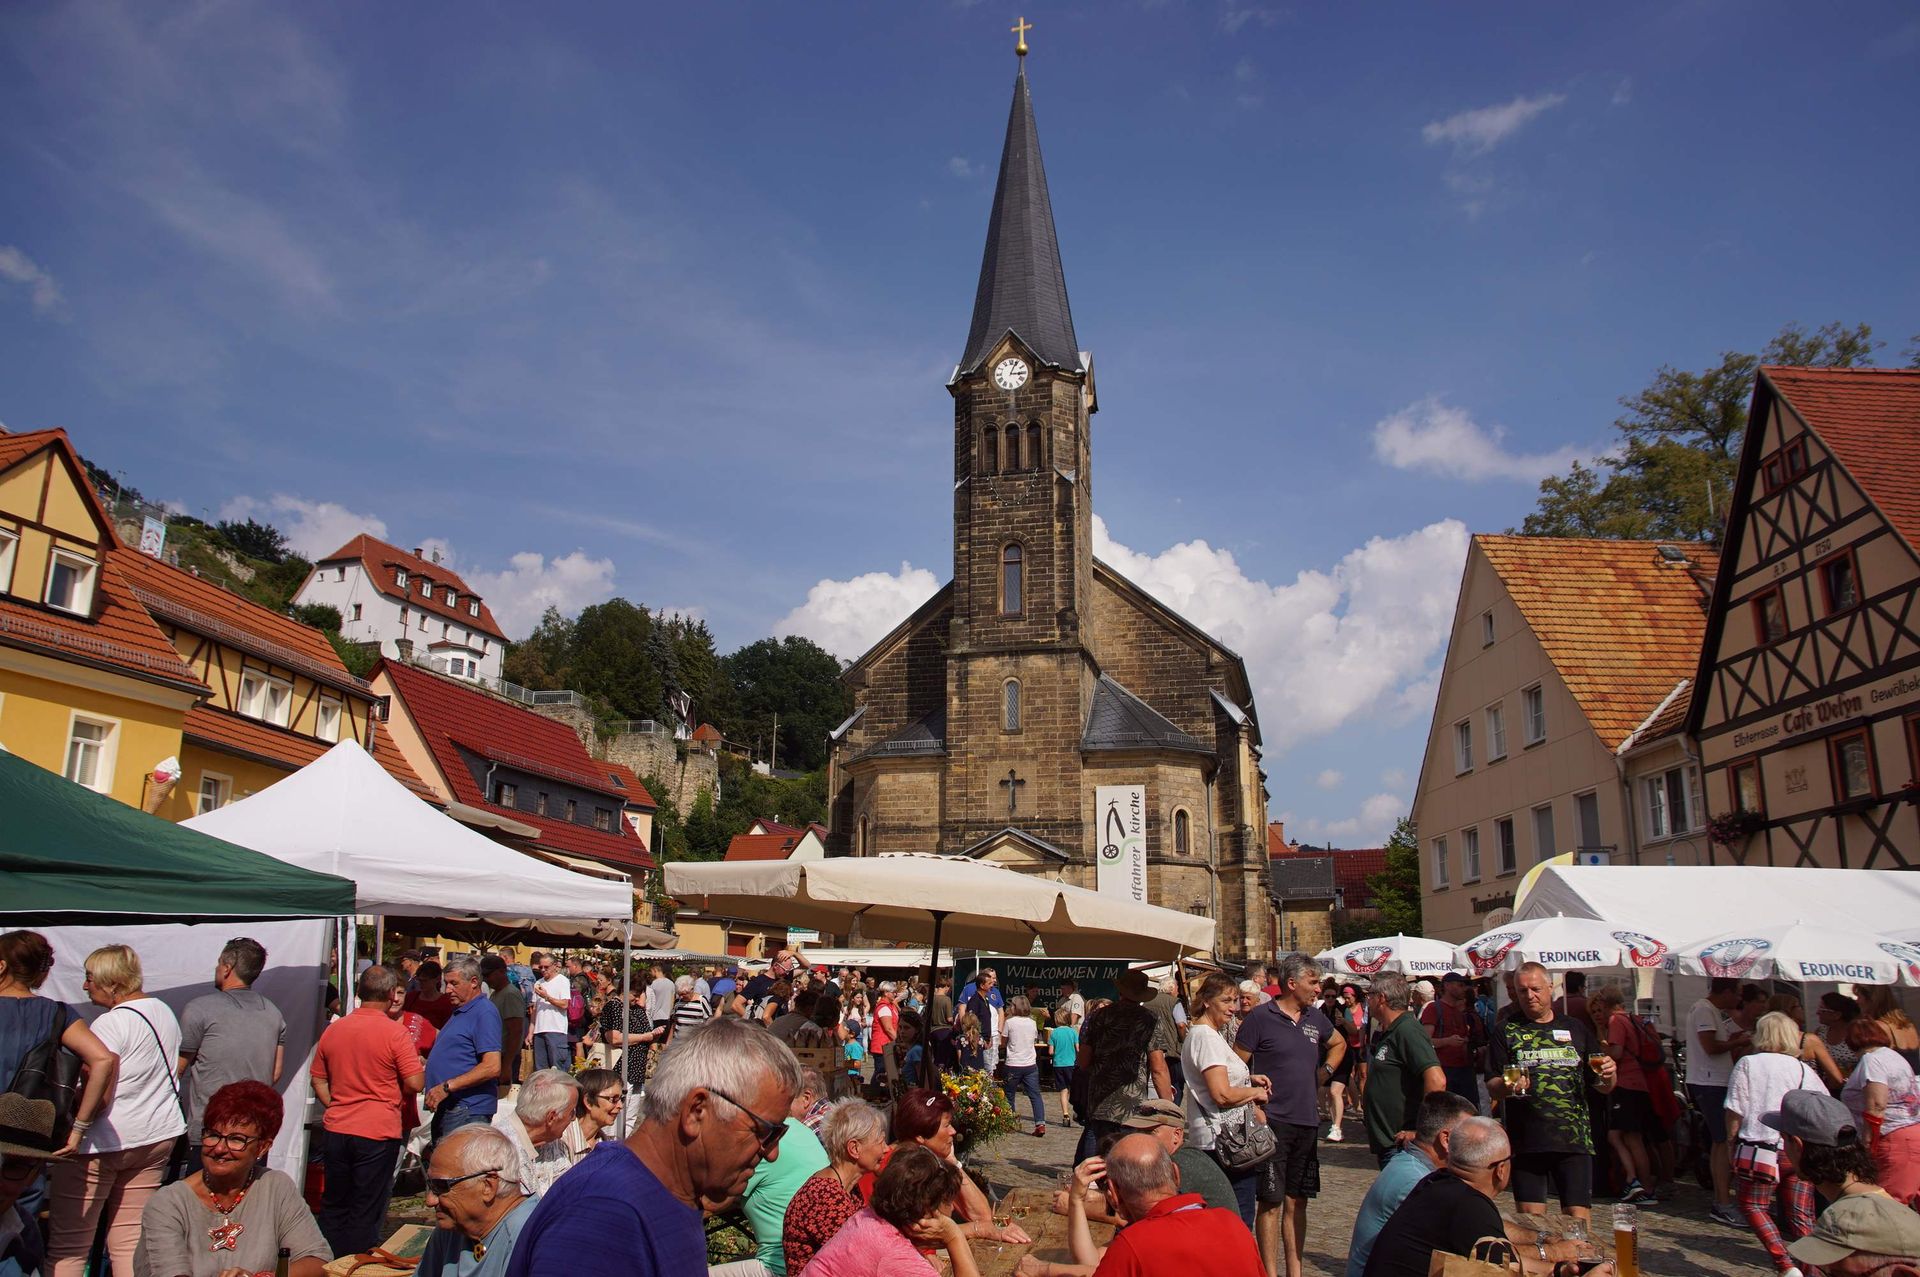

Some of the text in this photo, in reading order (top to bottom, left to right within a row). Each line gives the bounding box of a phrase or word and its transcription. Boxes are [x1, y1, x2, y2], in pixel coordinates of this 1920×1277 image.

[1733, 724, 1780, 748] Elbterrasse
[1130, 791, 1141, 834] kirche
[1539, 950, 1601, 963] ERDINGER
[1006, 964, 1119, 980] WILLKOMMEN IM
[1410, 961, 1453, 972] ERDINGER
[1799, 961, 1876, 981] ERDINGER
